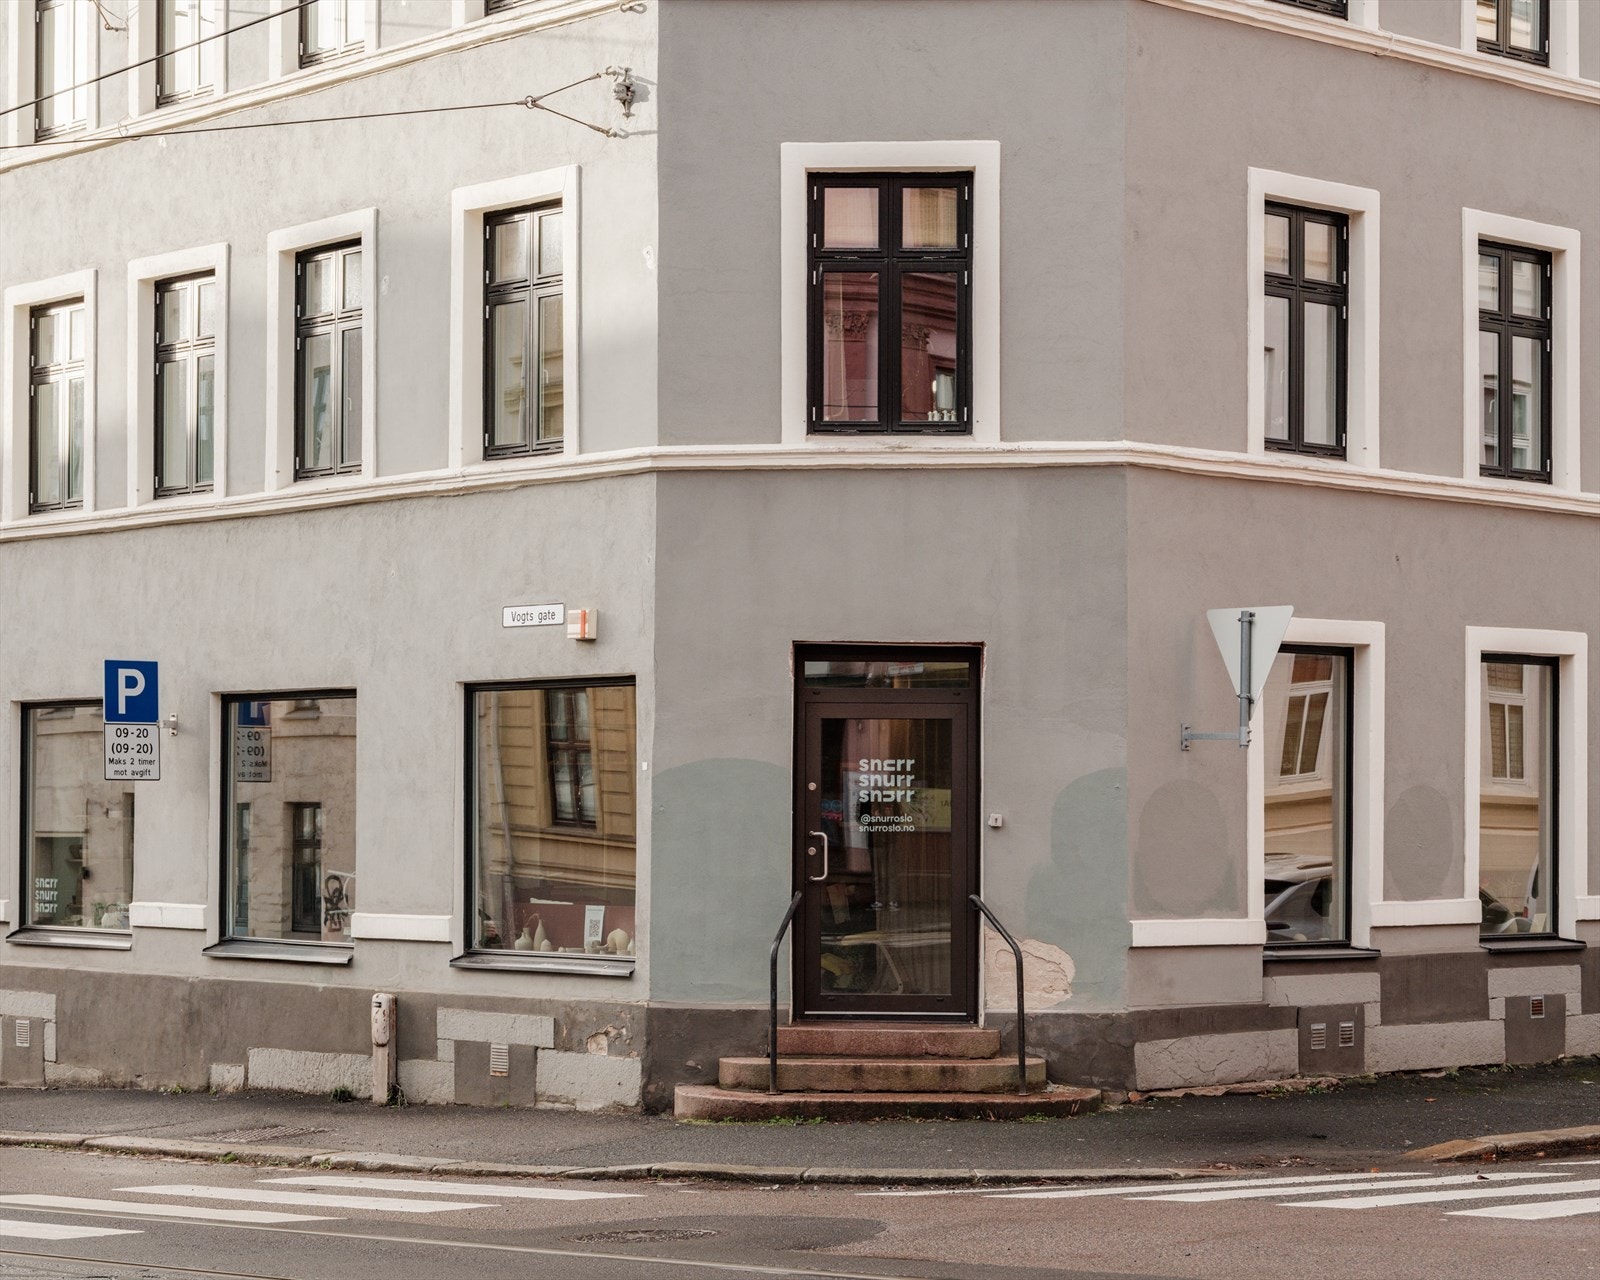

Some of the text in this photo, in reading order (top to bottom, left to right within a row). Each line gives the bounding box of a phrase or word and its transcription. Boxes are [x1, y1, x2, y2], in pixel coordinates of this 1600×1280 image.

[511, 609, 556, 624] Vogts gate
[117, 668, 146, 714] P
[108, 757, 156, 766] Maks 2 timer
[113, 768, 151, 778] mot avgift
[859, 774, 915, 788] snurr
[860, 813, 913, 825] @snurroslo
[859, 824, 915, 832] snurroslo.no
[35, 890, 58, 901] snurr
